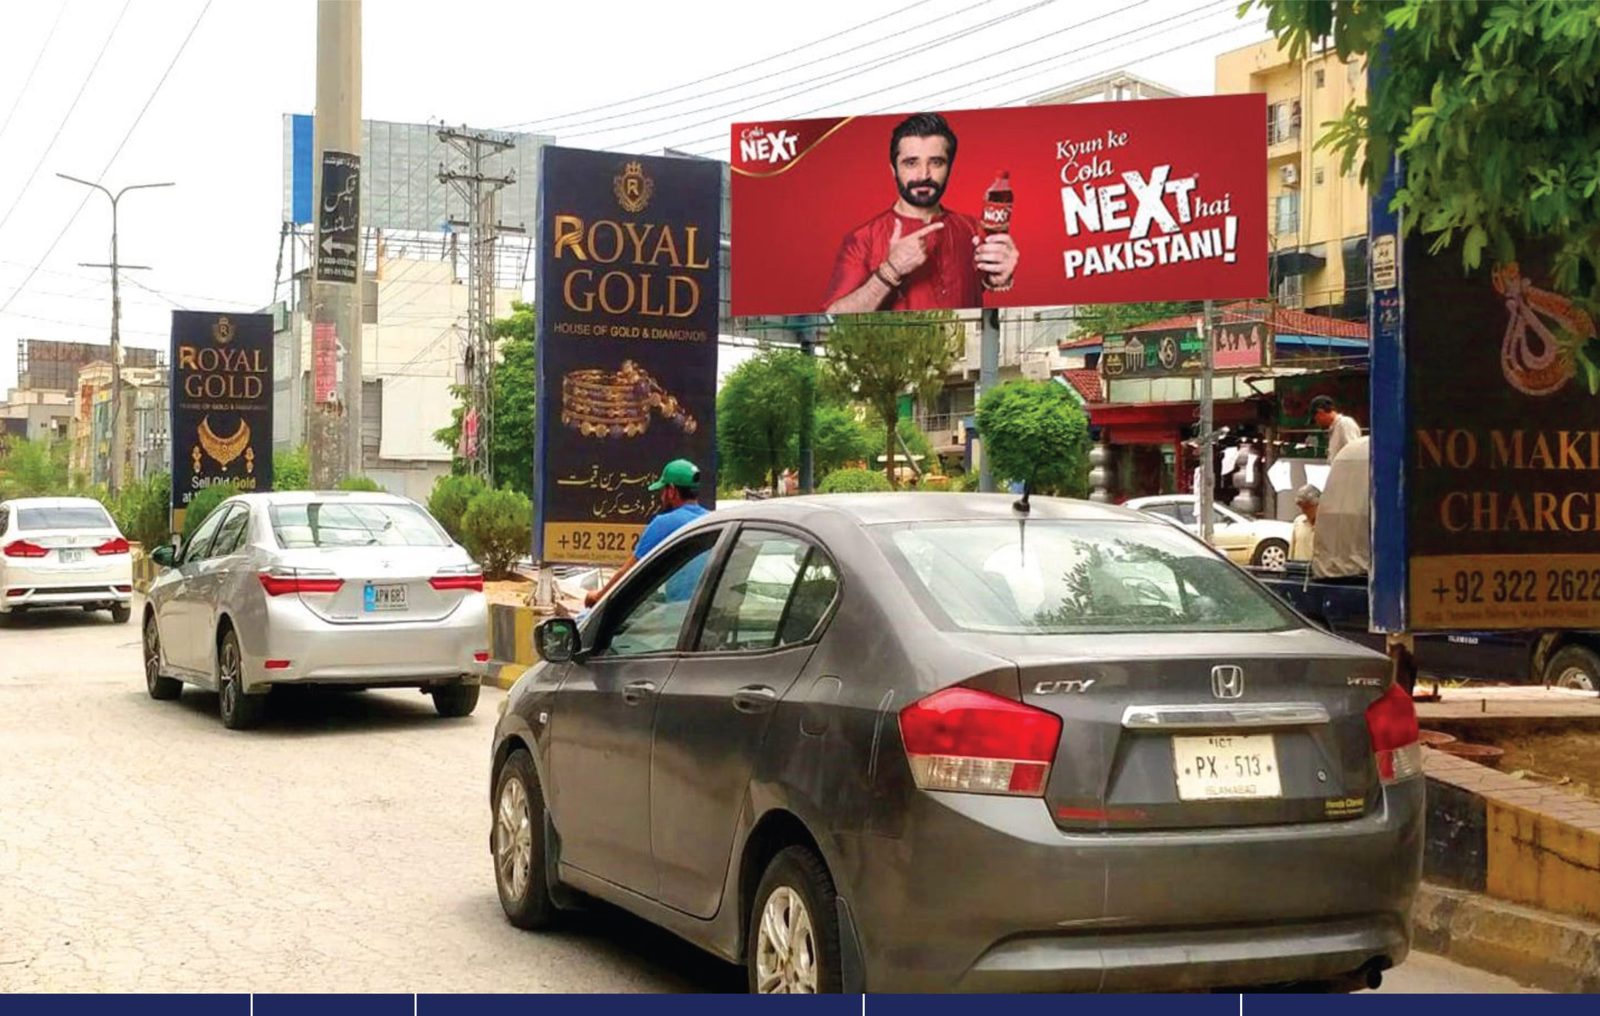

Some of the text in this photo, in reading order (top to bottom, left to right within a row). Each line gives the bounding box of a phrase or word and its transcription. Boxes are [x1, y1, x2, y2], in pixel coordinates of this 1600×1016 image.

[740, 130, 798, 163] NEXT
[1056, 130, 1129, 161] Kyun ke
[1060, 156, 1113, 184] Cola
[1060, 165, 1231, 239] NEXT hai
[554, 215, 710, 269] ROYAL
[1063, 216, 1237, 279] PAKISTANI!
[563, 269, 700, 318] GOLD
[554, 322, 707, 342] HOUSE OF GOLD & DIAMONDS
[179, 346, 268, 373] ROYAL
[185, 374, 263, 399] GOLD
[1417, 430, 1477, 469] NO
[191, 476, 210, 489] Sell
[232, 476, 256, 489] Gold
[597, 532, 625, 551] 322
[1493, 570, 1537, 602] 322
[1033, 680, 1096, 694] CITY
[1196, 755, 1260, 778] PX 513
